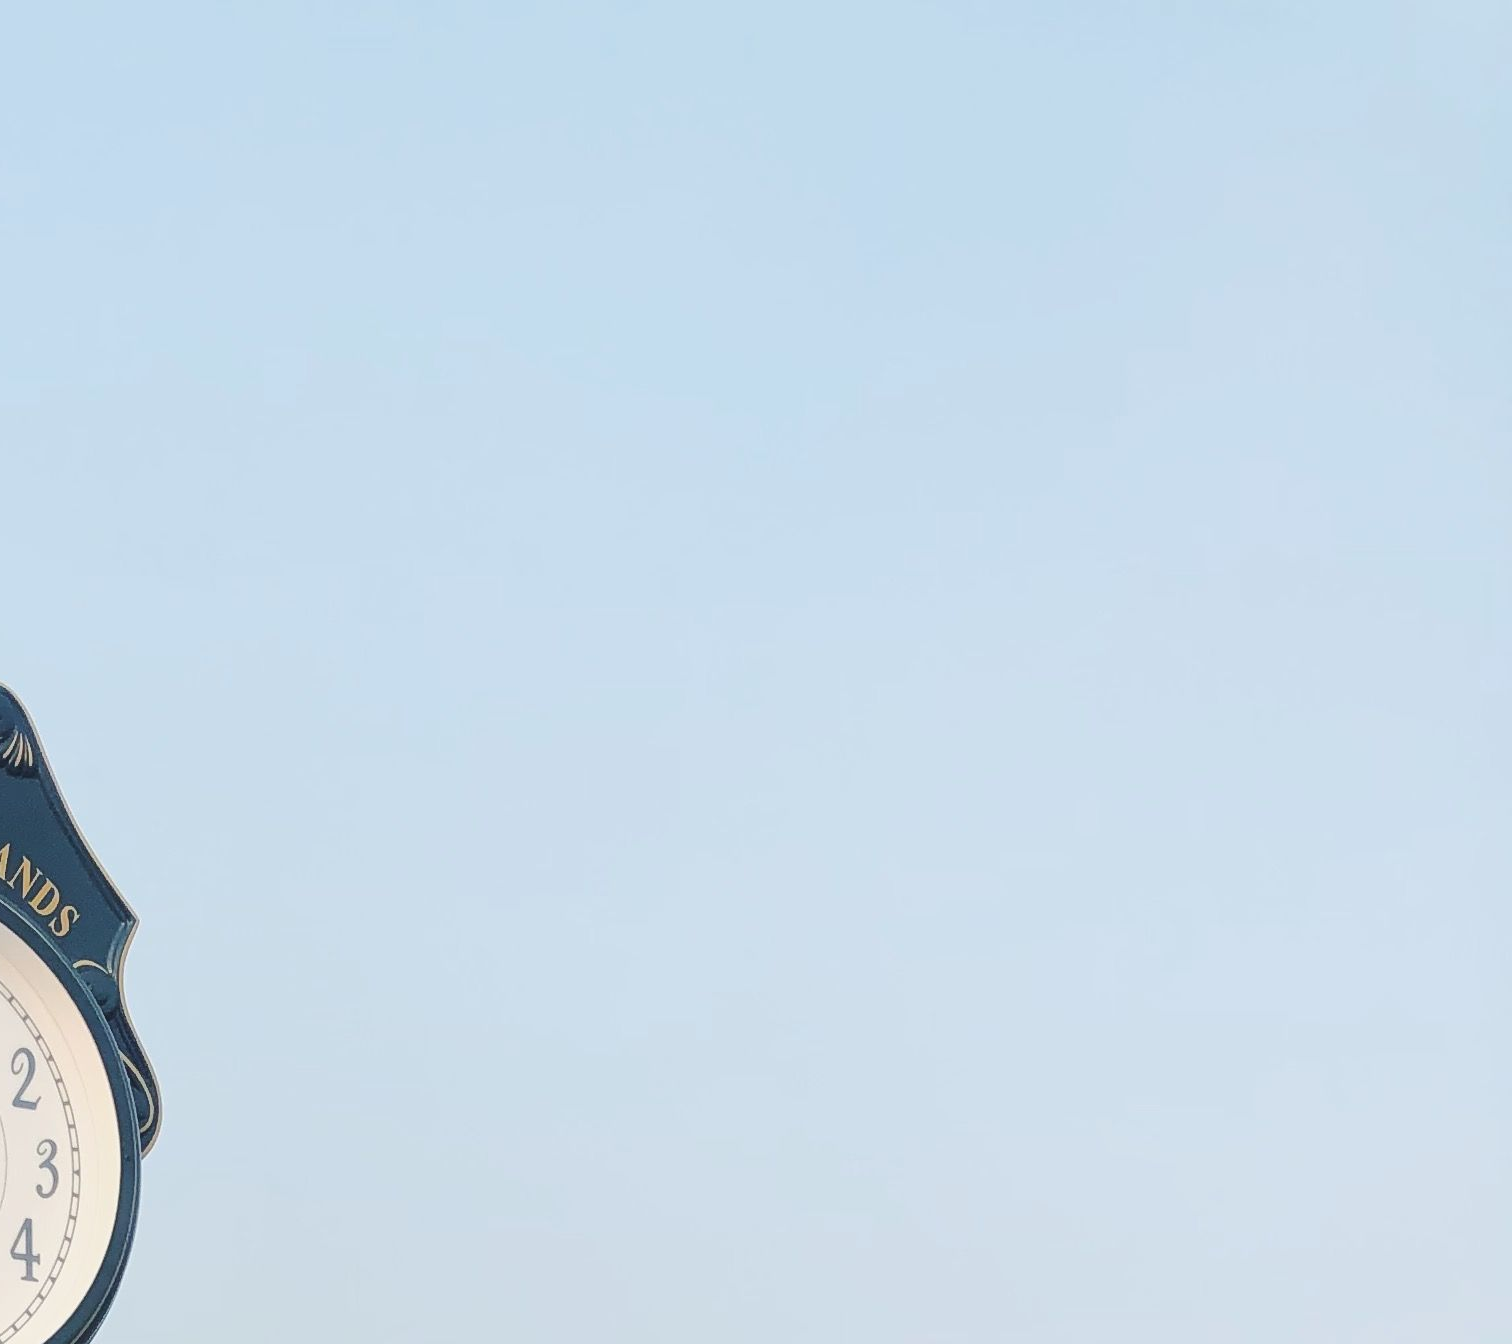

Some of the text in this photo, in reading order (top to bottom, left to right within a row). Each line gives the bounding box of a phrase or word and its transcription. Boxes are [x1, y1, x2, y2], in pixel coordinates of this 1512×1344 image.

[11, 1047, 42, 1110] 2
[35, 1138, 60, 1199] 3
[10, 1217, 41, 1282] 4
